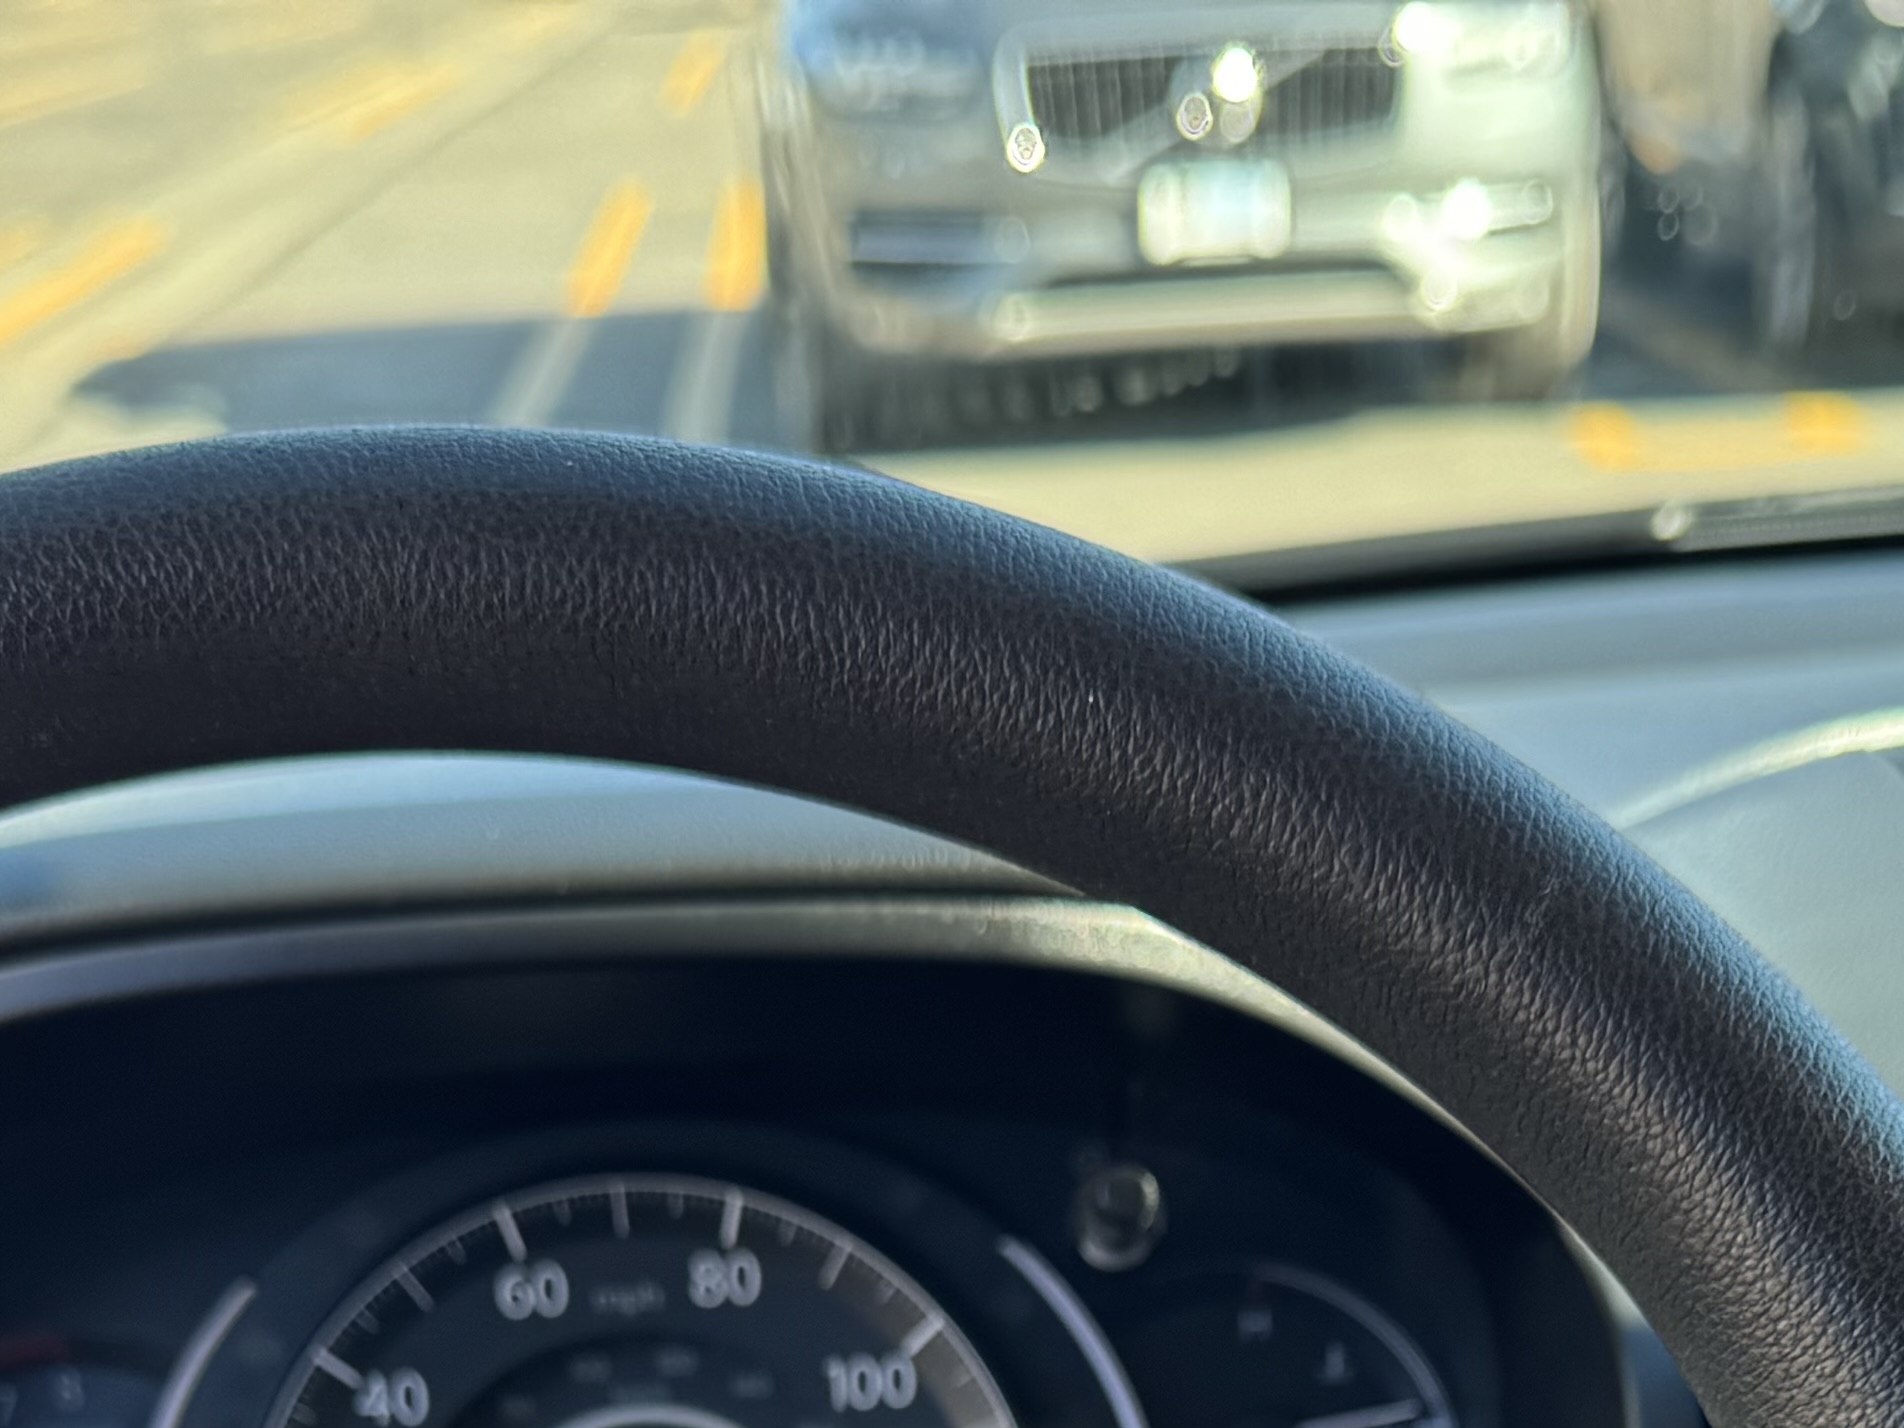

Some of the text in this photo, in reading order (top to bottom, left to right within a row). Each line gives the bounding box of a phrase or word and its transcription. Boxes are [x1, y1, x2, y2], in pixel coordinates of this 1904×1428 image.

[496, 1258, 569, 1321] 60
[688, 1248, 762, 1308] 80
[355, 1367, 429, 1427] 40
[826, 1351, 916, 1411] 100
